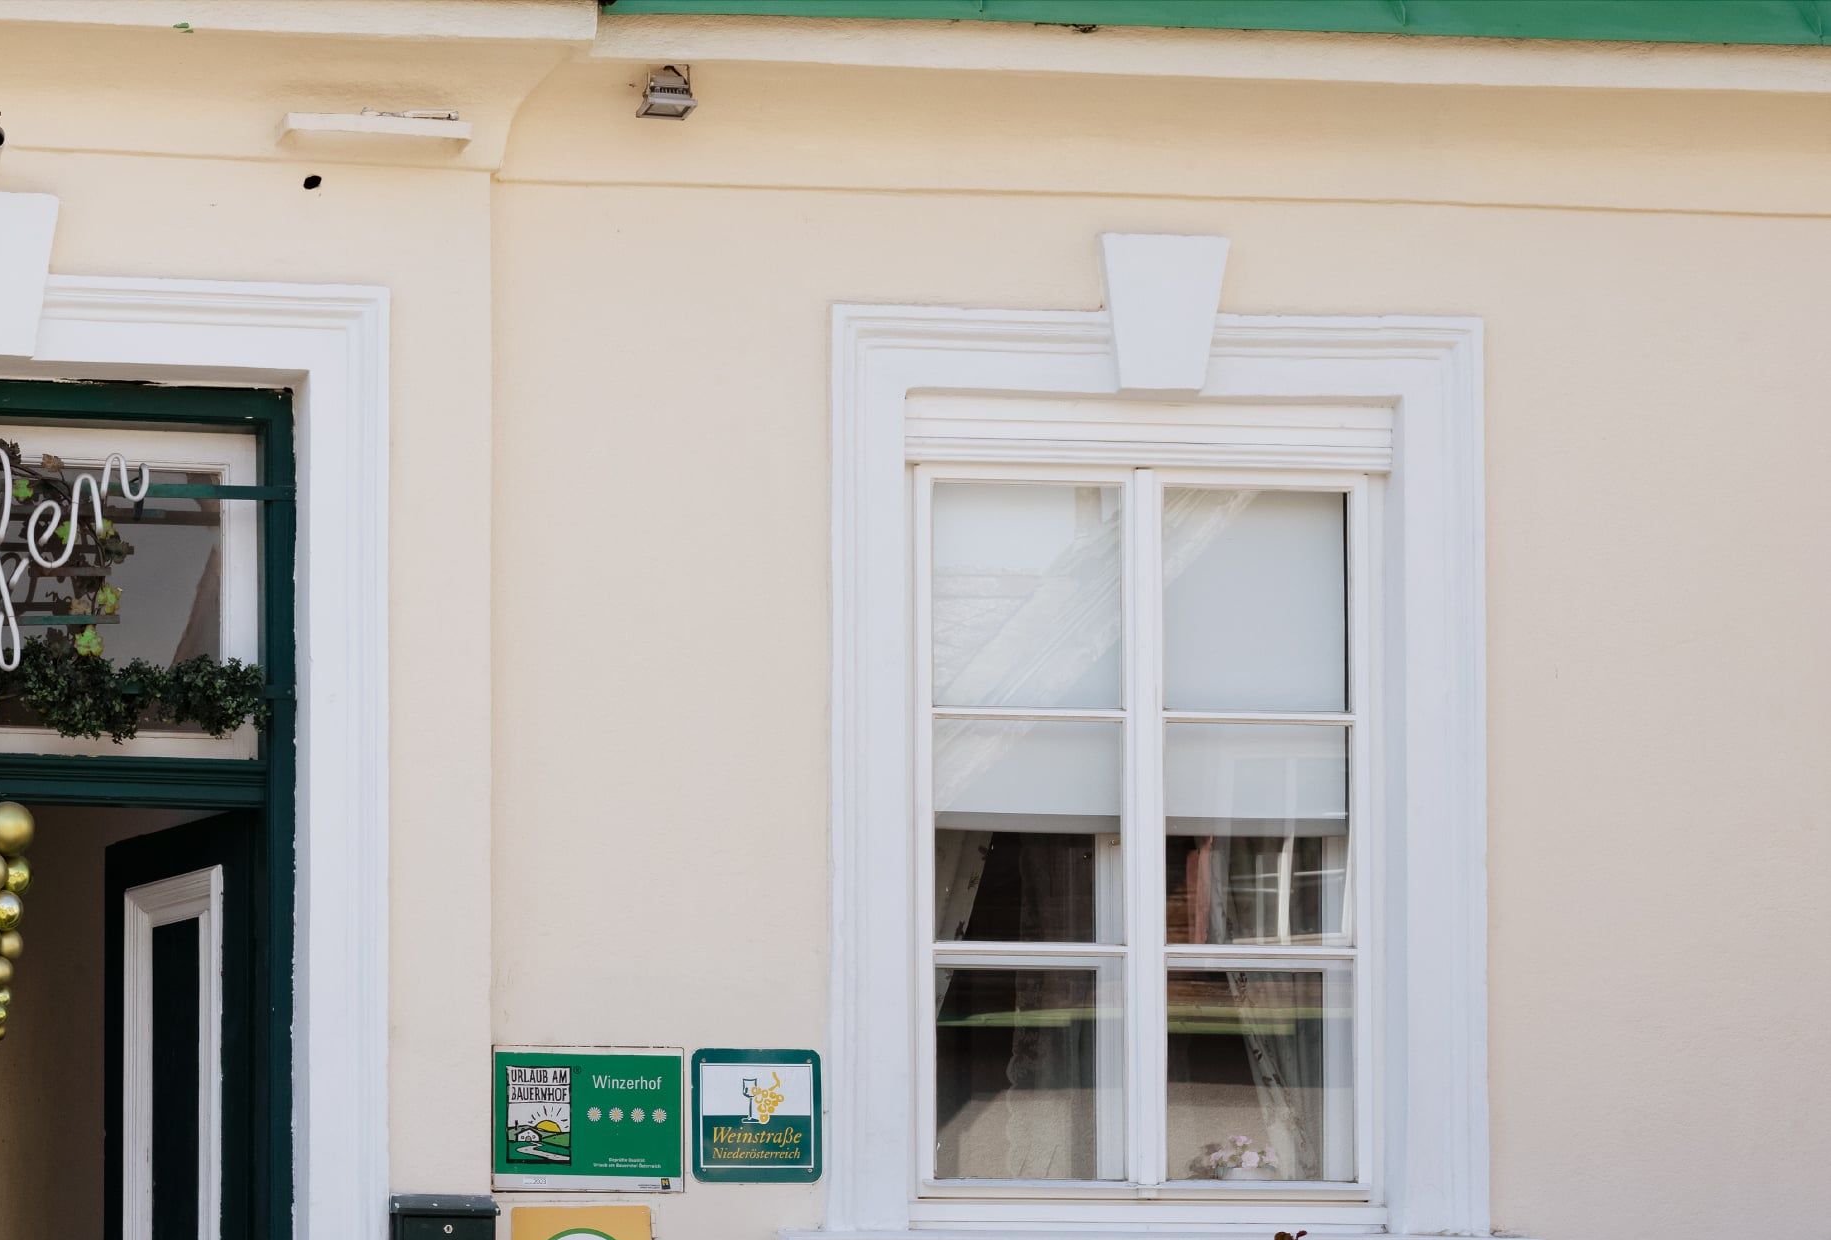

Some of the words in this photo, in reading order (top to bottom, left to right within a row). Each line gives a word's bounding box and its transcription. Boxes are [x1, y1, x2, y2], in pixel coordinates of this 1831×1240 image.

[510, 1069, 549, 1084] URLAUB
[552, 1070, 568, 1084] AM
[591, 1074, 663, 1091] Winzerhof
[511, 1086, 568, 1102] BAUERNHOF
[713, 1126, 803, 1148] Weinstraße
[712, 1147, 801, 1159] Niederösterreich
